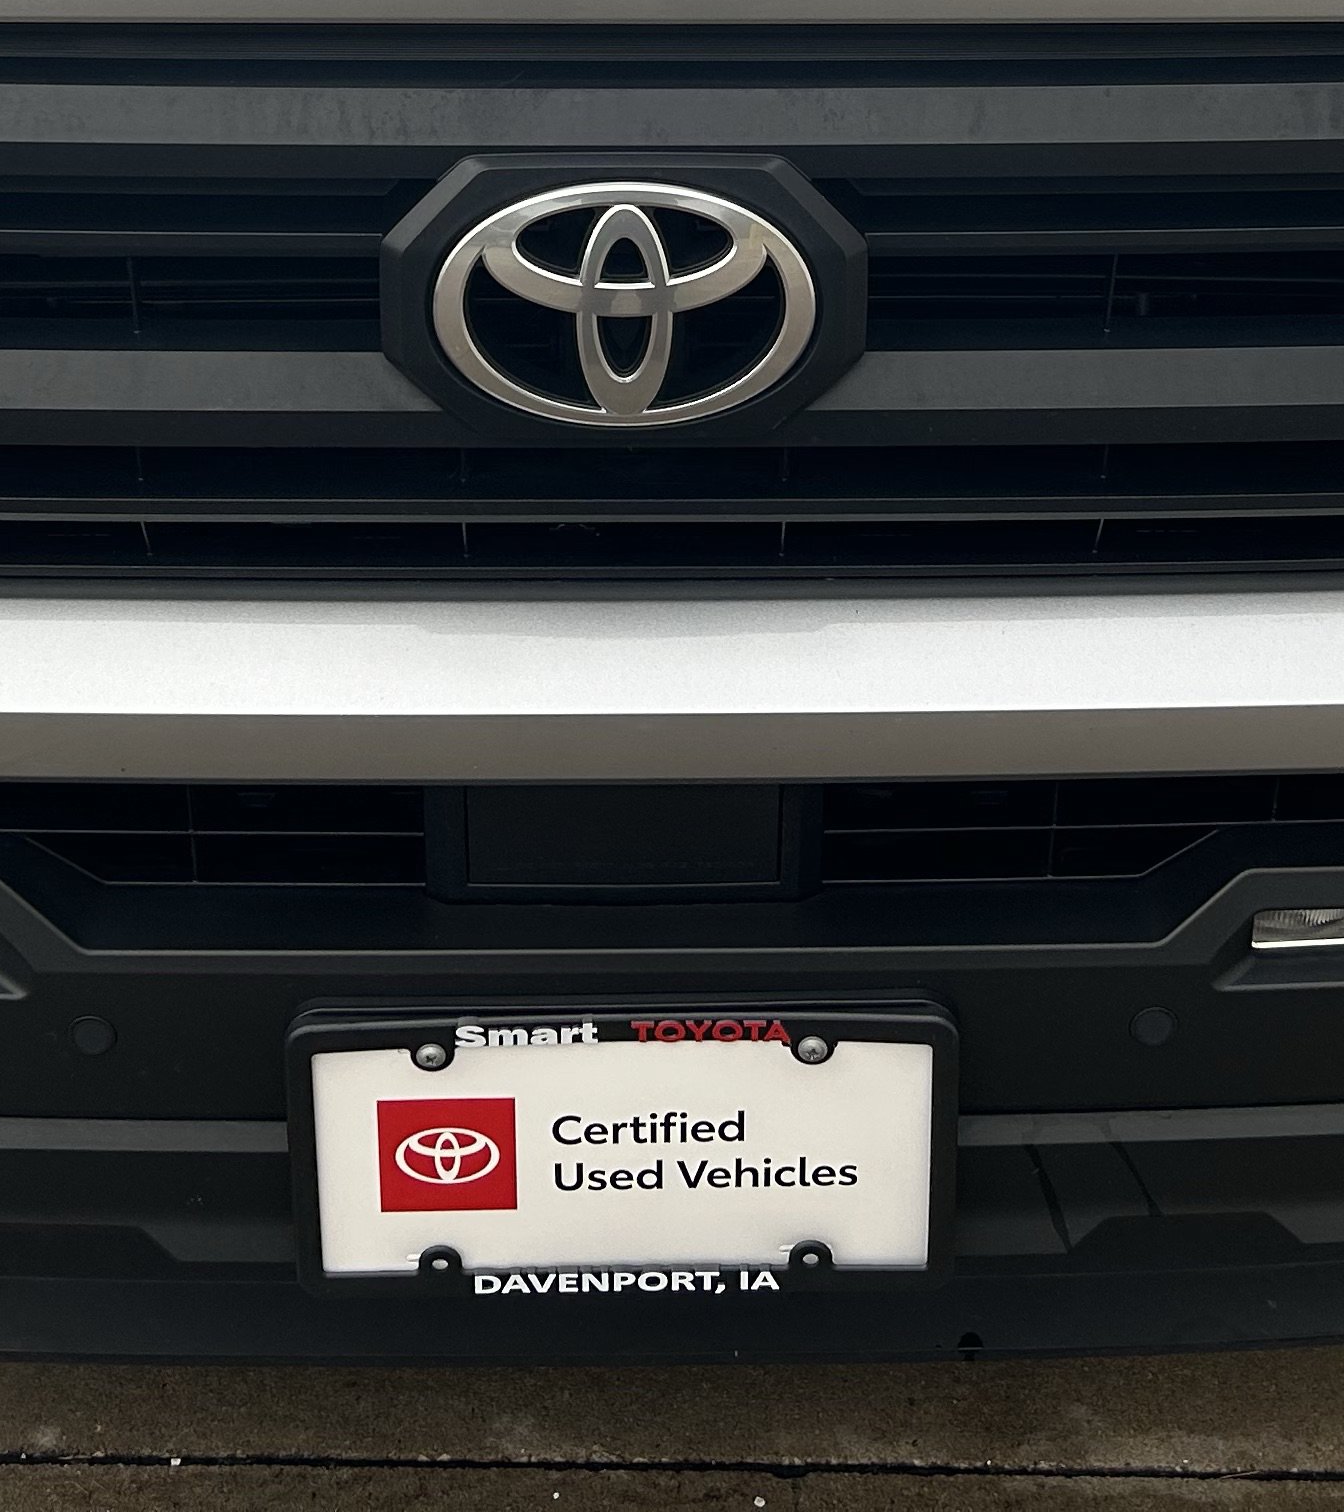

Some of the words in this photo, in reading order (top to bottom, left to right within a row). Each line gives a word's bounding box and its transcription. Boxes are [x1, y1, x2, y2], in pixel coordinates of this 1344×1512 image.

[455, 1021, 598, 1049] Smart
[631, 1020, 791, 1043] TOYOTA
[551, 1111, 746, 1145] Certified
[553, 1159, 664, 1191] Used
[676, 1157, 859, 1190] Vehicles
[473, 1271, 727, 1295] DAVENPORT,
[740, 1270, 780, 1292] IA
